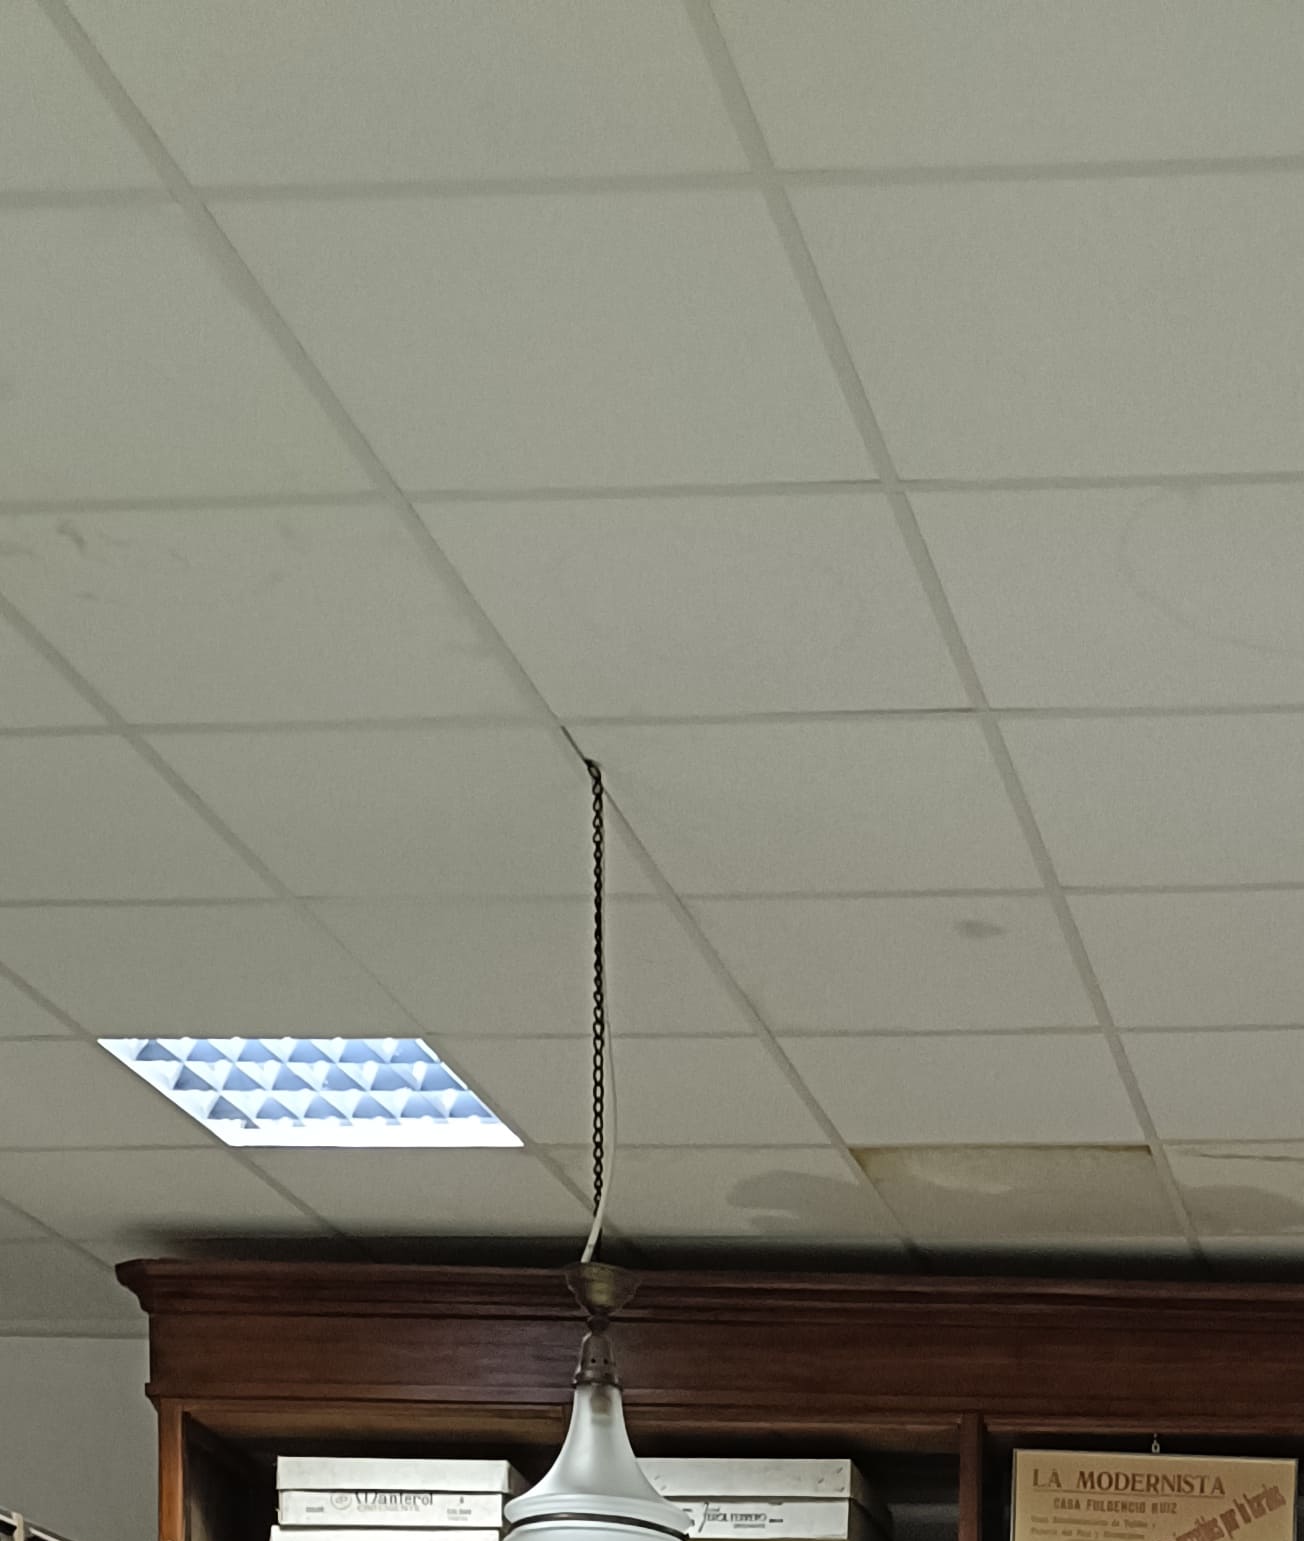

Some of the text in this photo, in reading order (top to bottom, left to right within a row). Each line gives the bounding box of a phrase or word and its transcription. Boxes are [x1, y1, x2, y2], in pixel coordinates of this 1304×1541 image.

[1033, 1468, 1225, 1495] LA MODERNISTA
[1053, 1498, 1081, 1510] CASA
[1152, 1502, 1177, 1514] RUIZ
